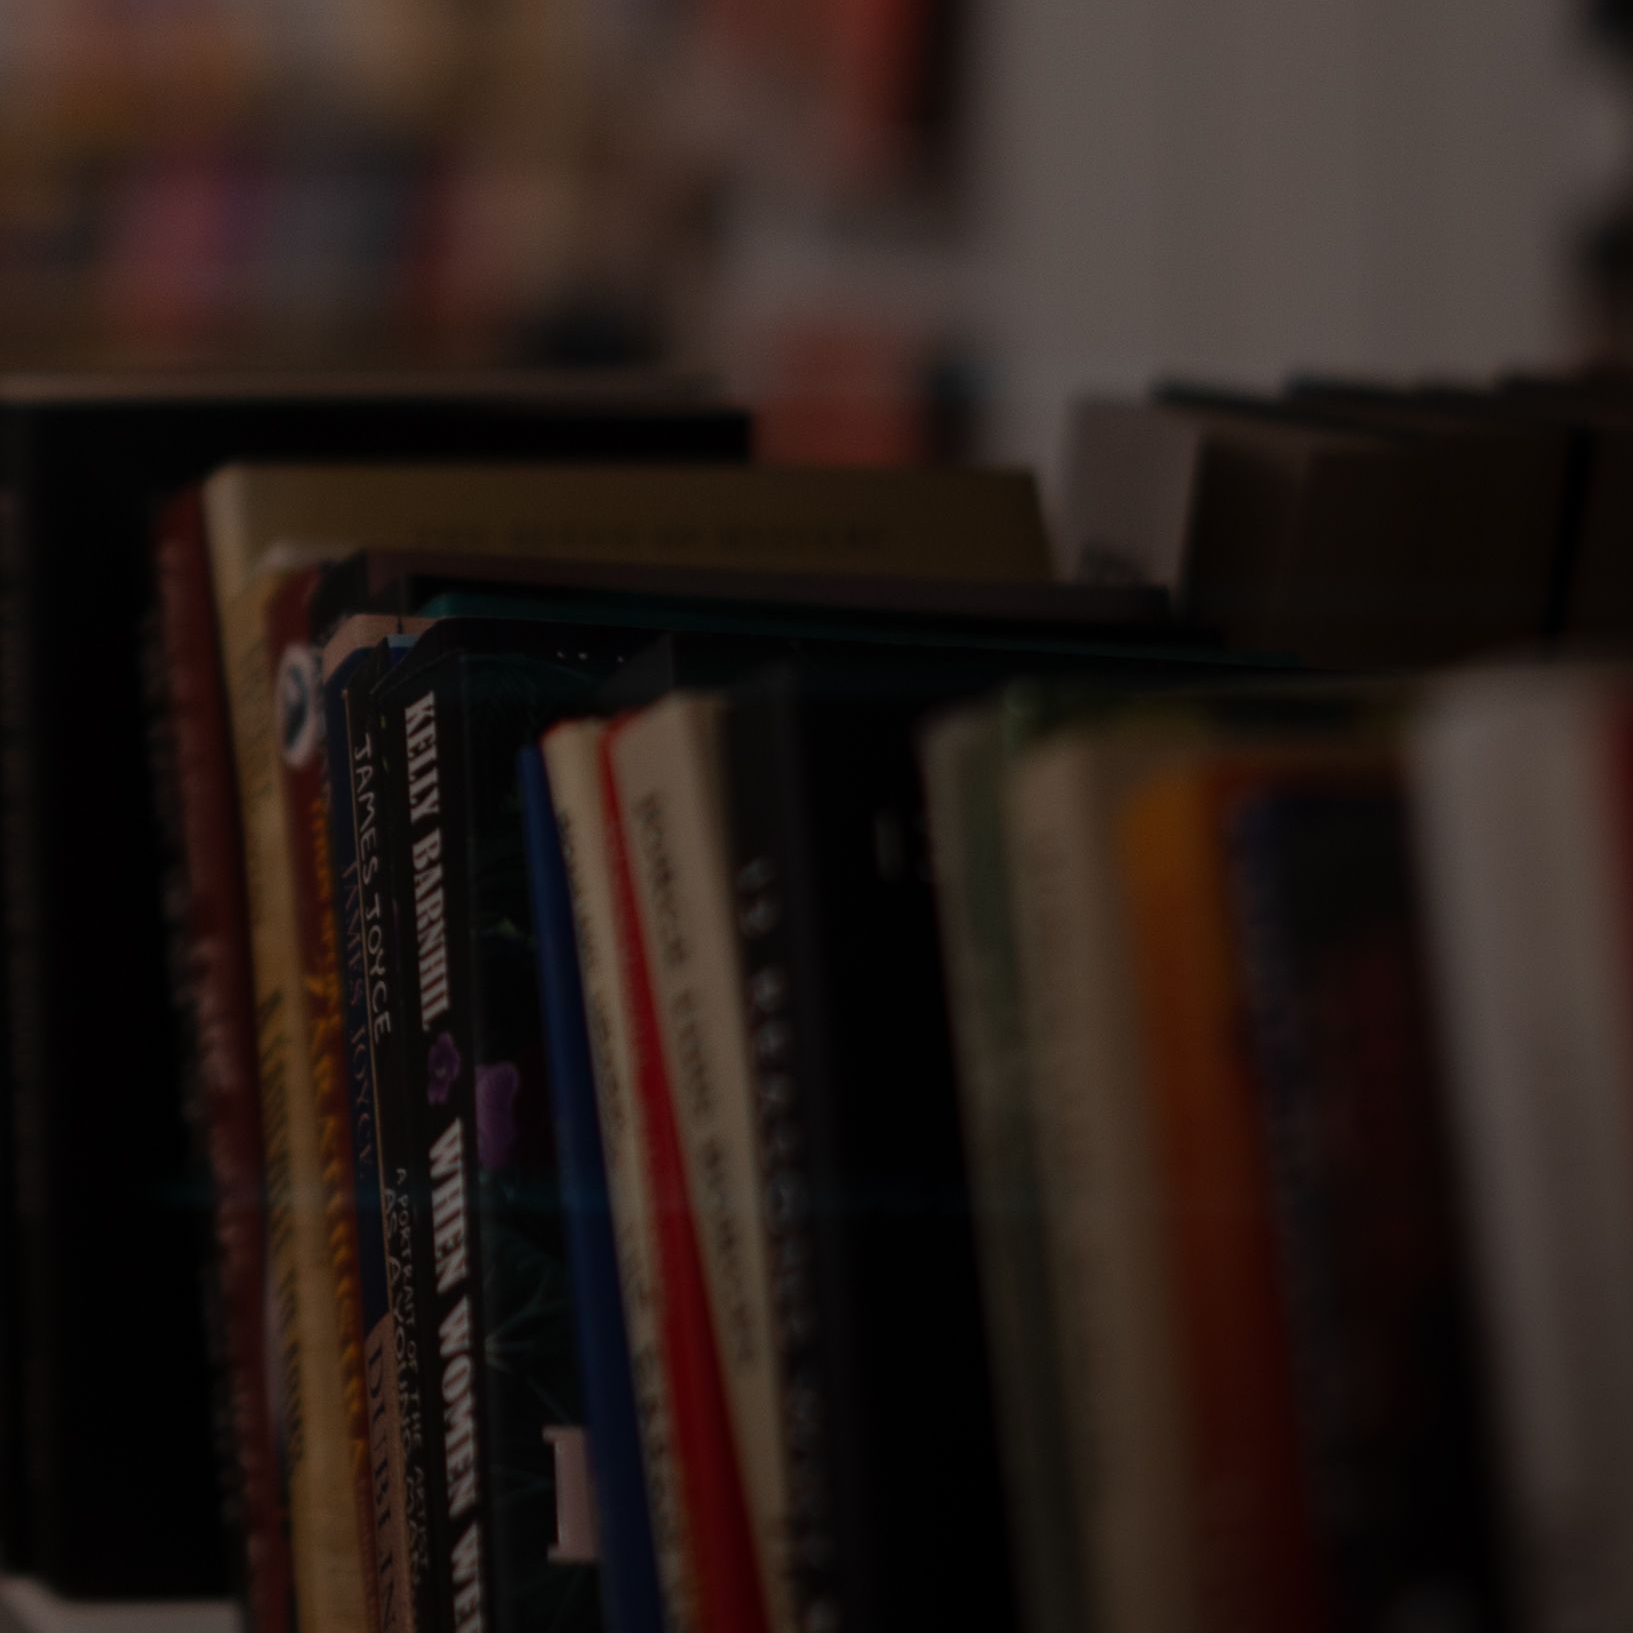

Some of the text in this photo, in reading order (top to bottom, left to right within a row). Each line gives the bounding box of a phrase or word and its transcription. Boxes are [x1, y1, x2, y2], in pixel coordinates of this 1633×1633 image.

[404, 689, 440, 825] KELLY
[354, 732, 393, 1044] JAMES JOYCE
[384, 1186, 398, 1238] AS
[394, 1167, 408, 1186] A
[428, 1116, 469, 1295] WHEN
[387, 1253, 402, 1286] A
[396, 1191, 416, 1326] PORTRAIT
[406, 1338, 420, 1378] OF
[438, 1293, 481, 1520] WOMEN
[408, 1387, 424, 1453] THE
